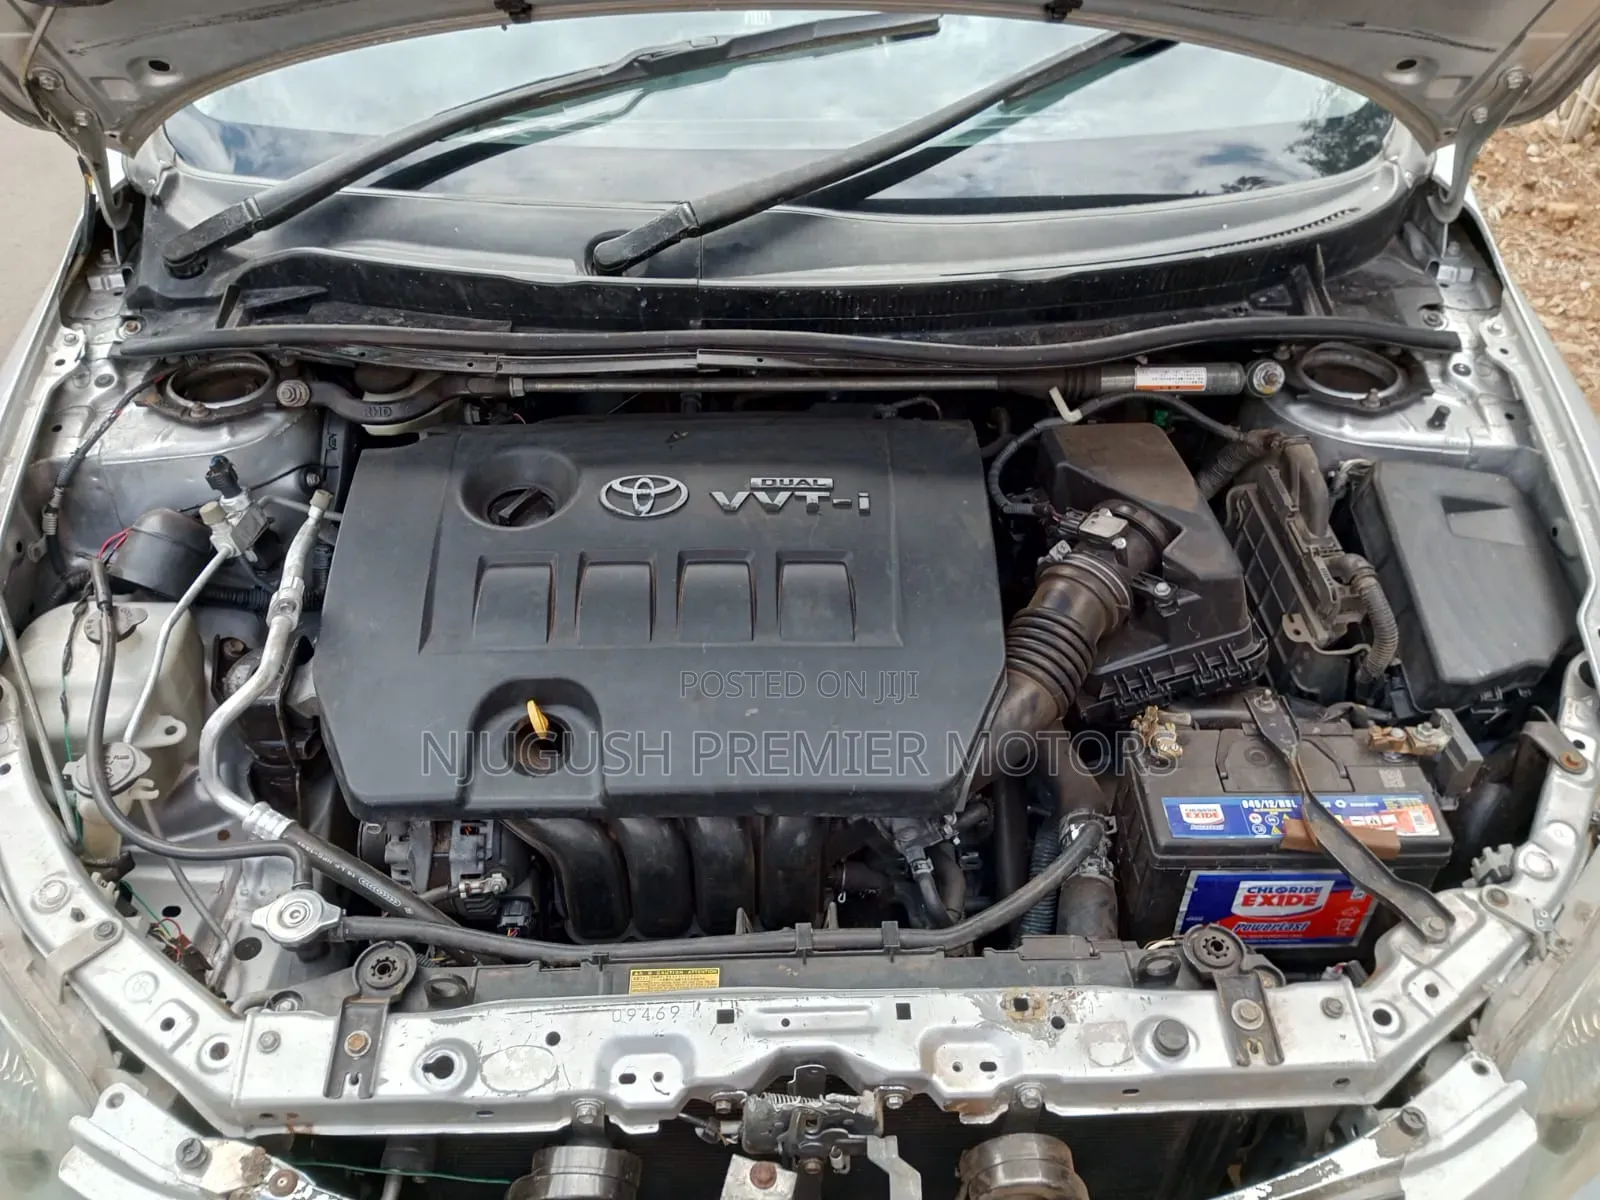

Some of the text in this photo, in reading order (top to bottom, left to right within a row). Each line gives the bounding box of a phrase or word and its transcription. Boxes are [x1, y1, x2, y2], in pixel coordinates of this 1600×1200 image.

[760, 478, 828, 488] DUAL
[710, 491, 871, 515] VVT-i
[1185, 811, 1220, 819] EXIDE
[1246, 886, 1324, 894] CHLORIDE
[1241, 894, 1319, 907] EXIDE
[611, 1005, 681, 1024] 09469
